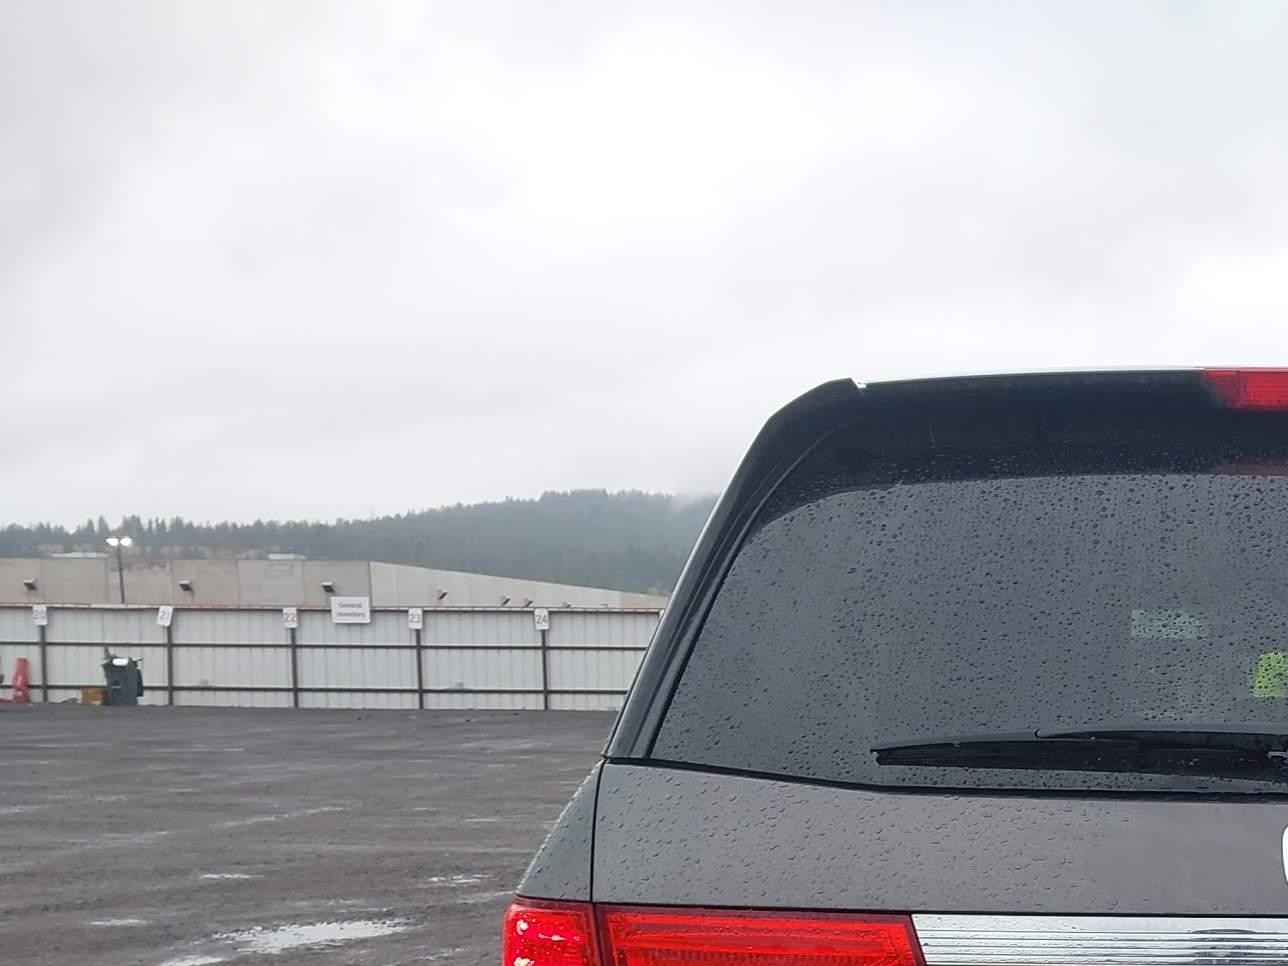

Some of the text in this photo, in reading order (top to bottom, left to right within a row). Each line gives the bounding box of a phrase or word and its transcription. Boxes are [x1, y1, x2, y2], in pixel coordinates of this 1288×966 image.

[283, 612, 296, 622] 22
[409, 613, 421, 623] 23
[535, 614, 548, 624] 24
